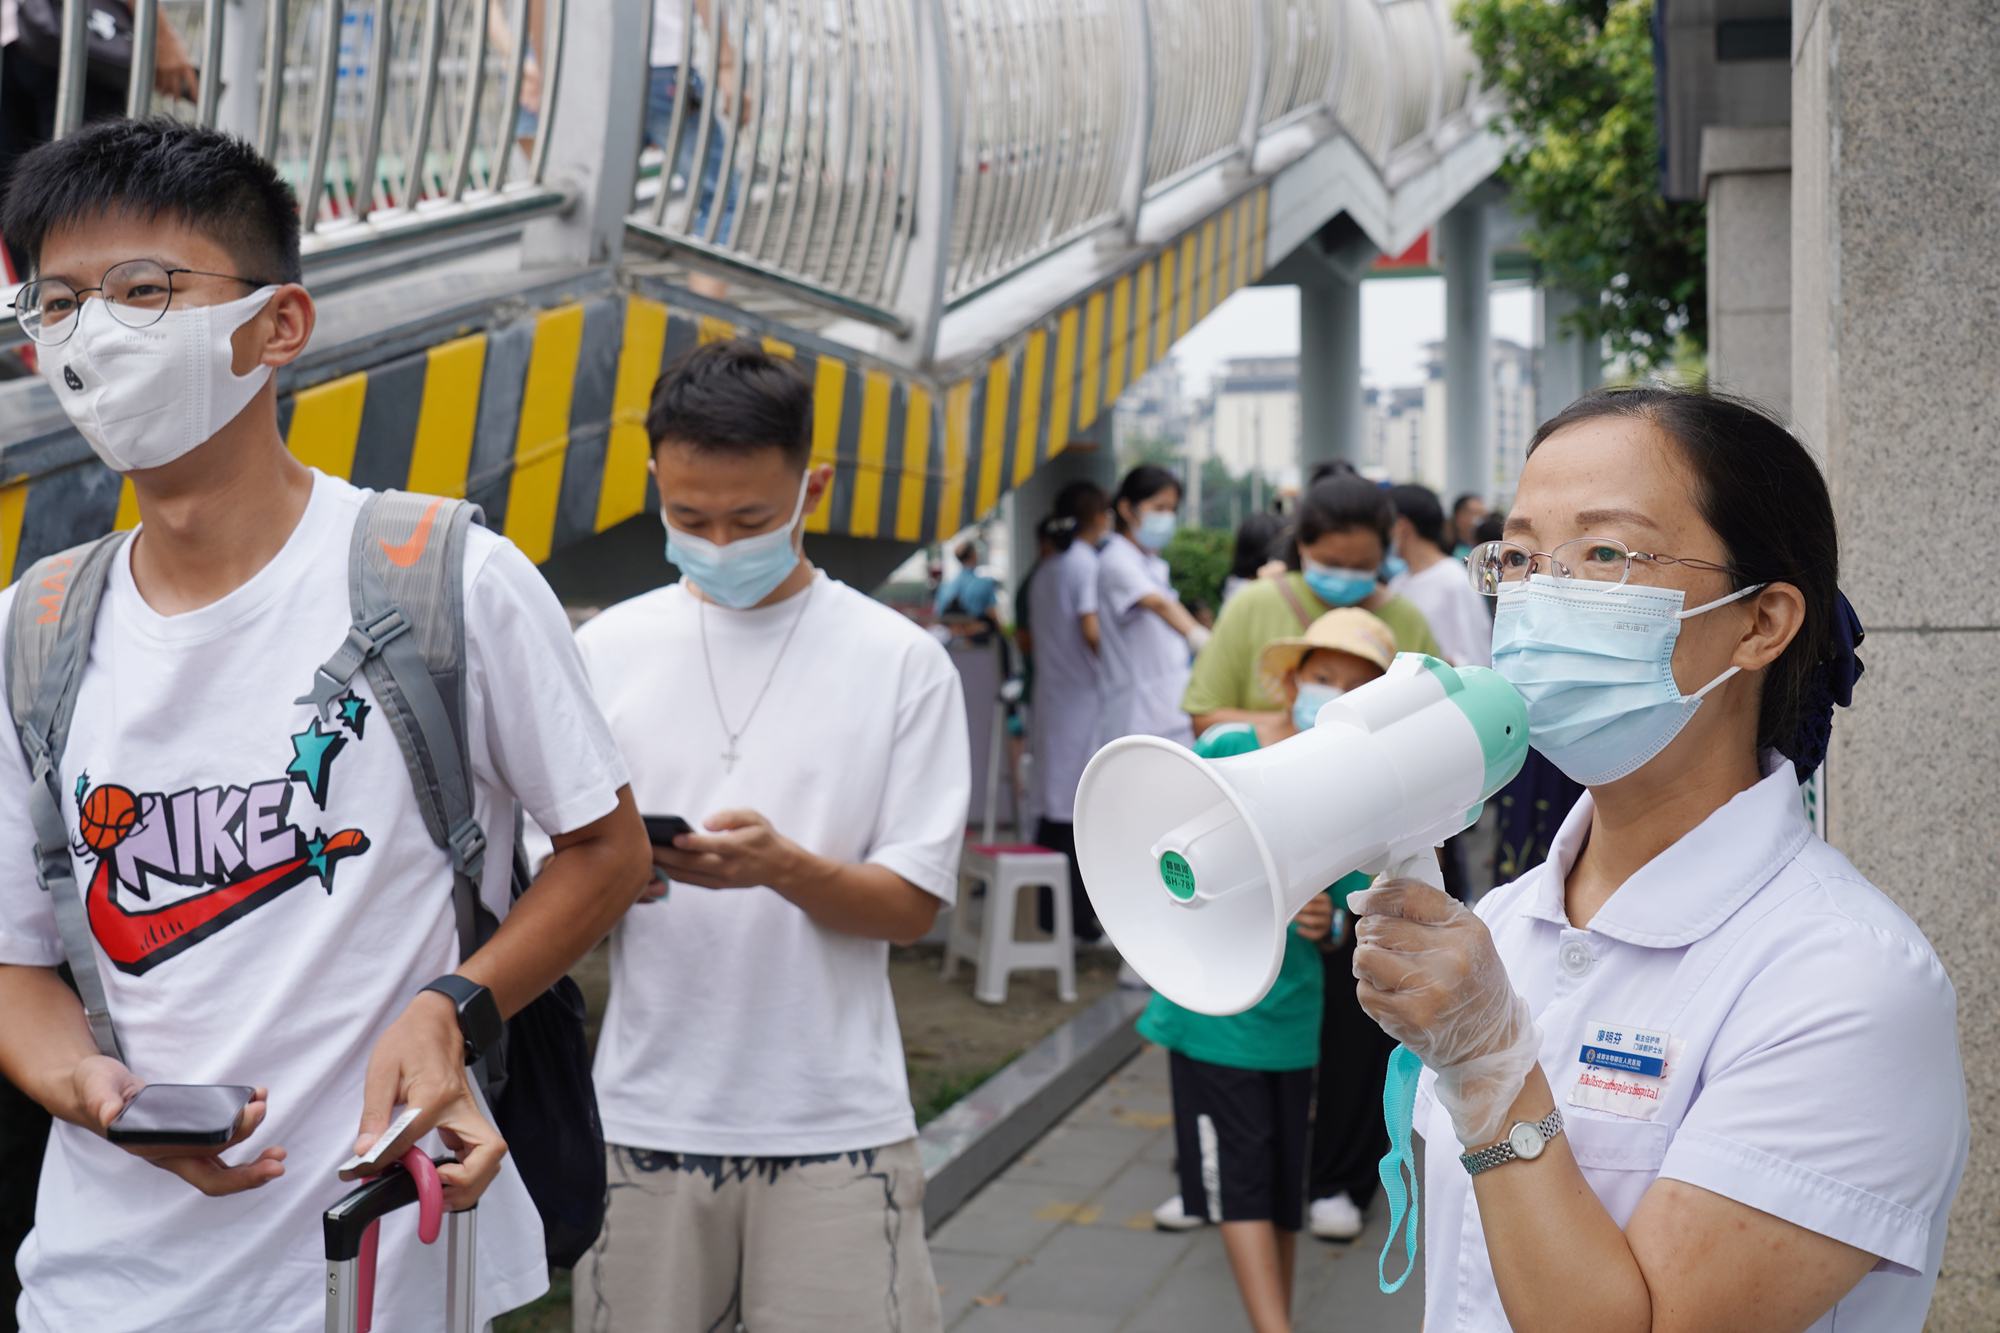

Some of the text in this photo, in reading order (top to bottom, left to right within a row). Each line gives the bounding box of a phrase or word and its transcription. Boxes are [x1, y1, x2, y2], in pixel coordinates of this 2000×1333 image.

[124, 332, 167, 343] Unifree
[37, 553, 79, 624] MAX
[112, 779, 303, 902] NIKE
[1596, 1029, 1622, 1045] 廖明芬
[1635, 1033, 1660, 1044] 副主任护师
[1632, 1043, 1663, 1055] 门诊部护士长
